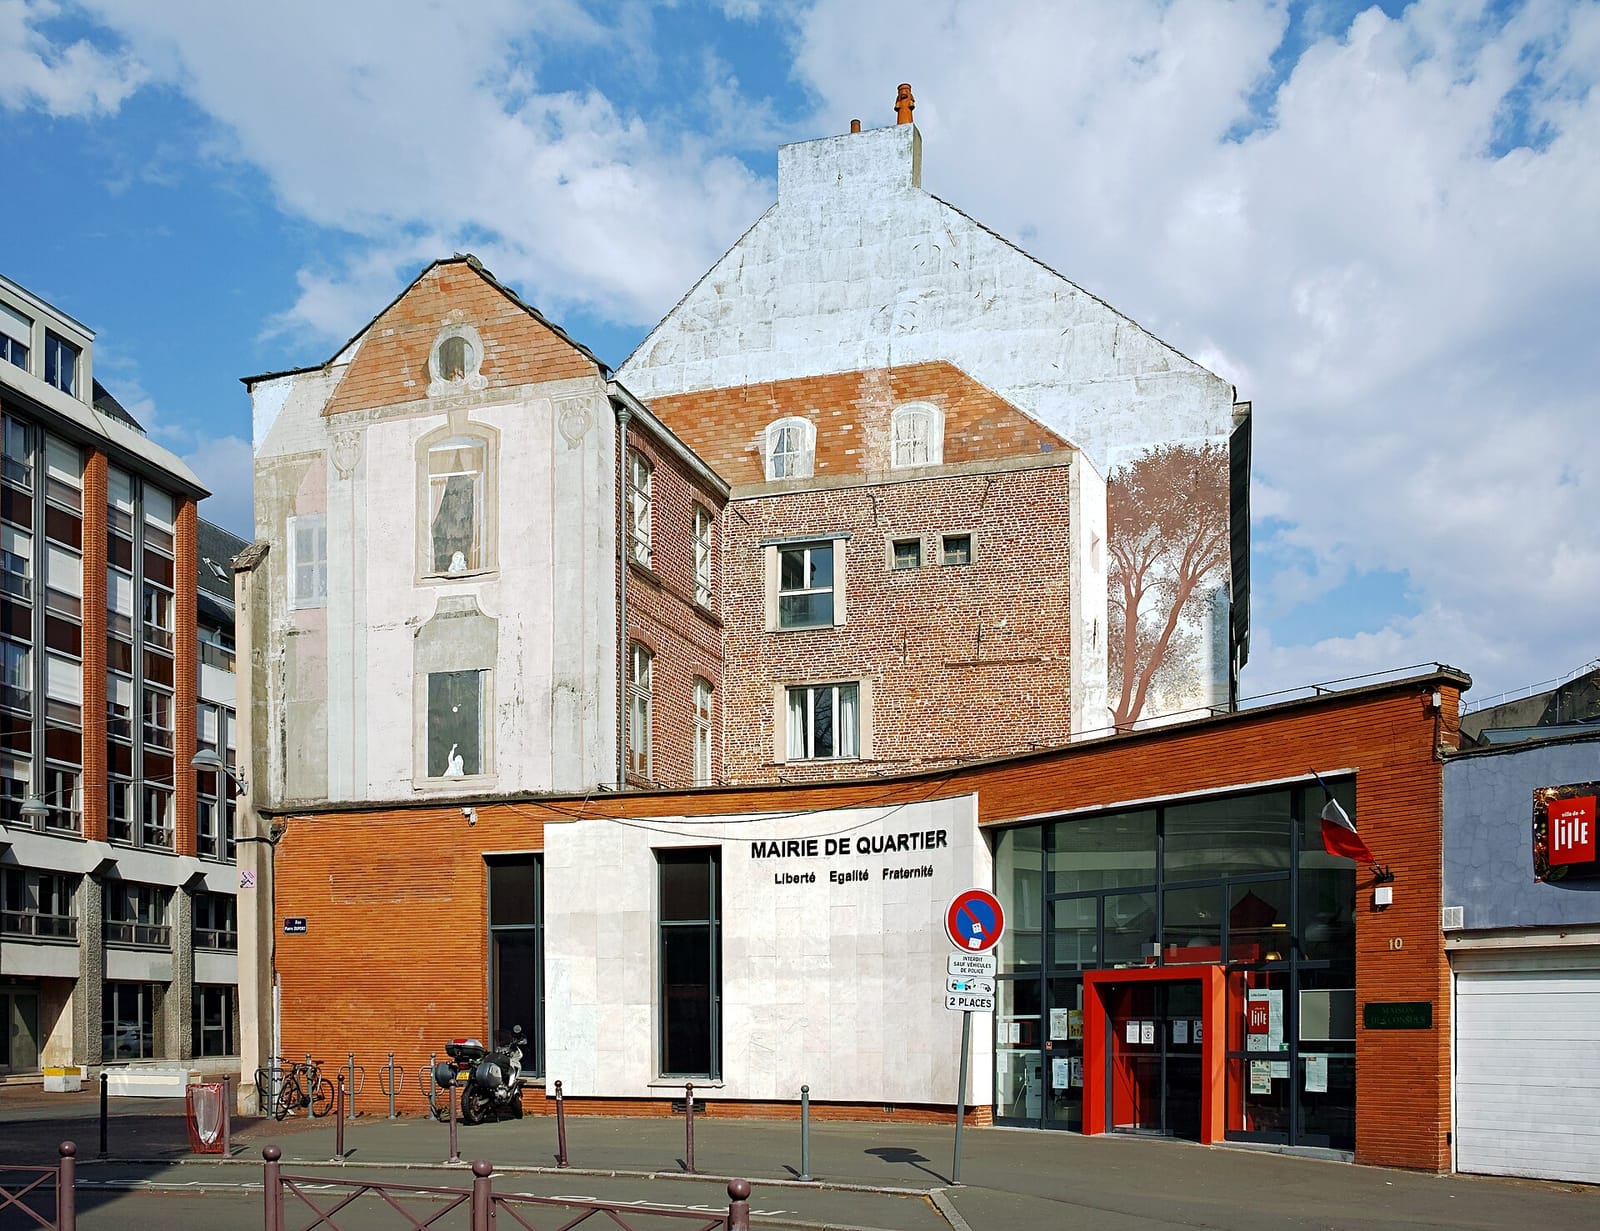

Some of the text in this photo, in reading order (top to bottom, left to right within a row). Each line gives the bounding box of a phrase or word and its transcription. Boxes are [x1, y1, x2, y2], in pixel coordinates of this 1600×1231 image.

[751, 829, 948, 859] MAIRIE DE QUARTIER
[774, 864, 934, 885] Liberté Egalité Fraternité
[1388, 937, 1403, 950] 10
[966, 961, 992, 969] VÉHICULES
[949, 996, 992, 1008] 2 PLACES
